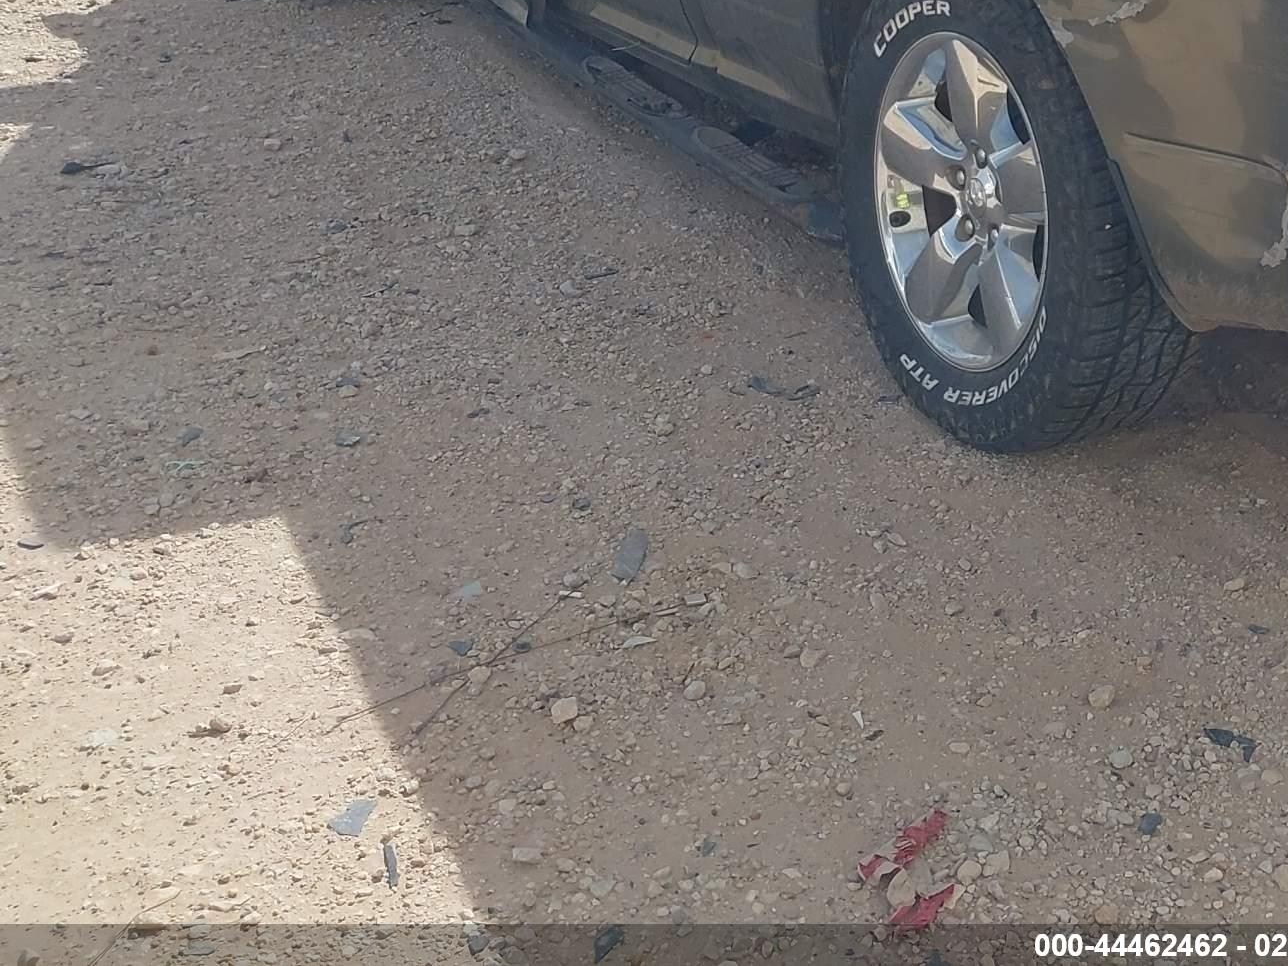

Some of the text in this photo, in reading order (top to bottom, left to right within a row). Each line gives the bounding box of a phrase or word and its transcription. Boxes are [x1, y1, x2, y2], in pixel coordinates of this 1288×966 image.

[873, 0, 951, 58] COOPER
[899, 305, 1047, 406] DISCOVERER ATP
